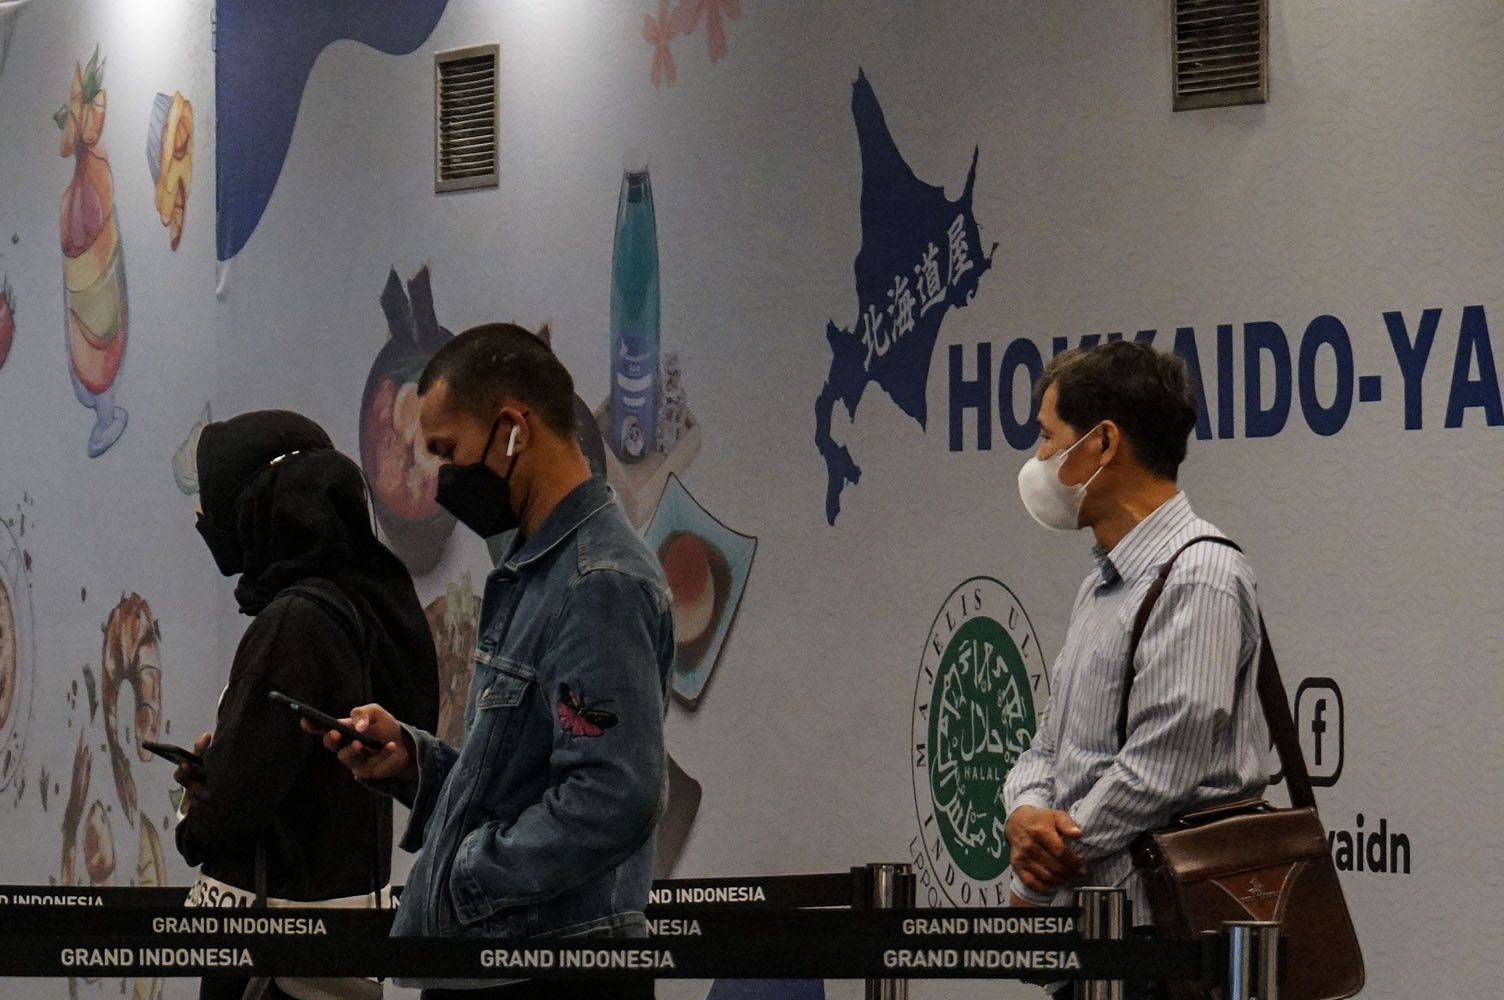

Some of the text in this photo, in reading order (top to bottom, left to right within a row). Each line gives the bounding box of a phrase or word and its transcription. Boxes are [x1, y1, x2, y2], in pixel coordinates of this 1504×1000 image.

[862, 213, 974, 372] 北海道屋
[949, 305, 1504, 452] HOAIDO-YA
[964, 766, 1000, 781] HALAL
[923, 813, 1014, 907] INDONE
[909, 835, 943, 908] LPPO
[676, 886, 766, 903] INDONESIA
[152, 917, 327, 935] GRAND INDONESIA
[645, 919, 702, 936] NESIA
[902, 917, 1074, 934] GRAND INDONESIA
[61, 948, 254, 967] GRAND INDONESIA
[480, 949, 675, 968] GRAND INDONESIA
[883, 950, 1081, 970] GRAND INDONESIA
